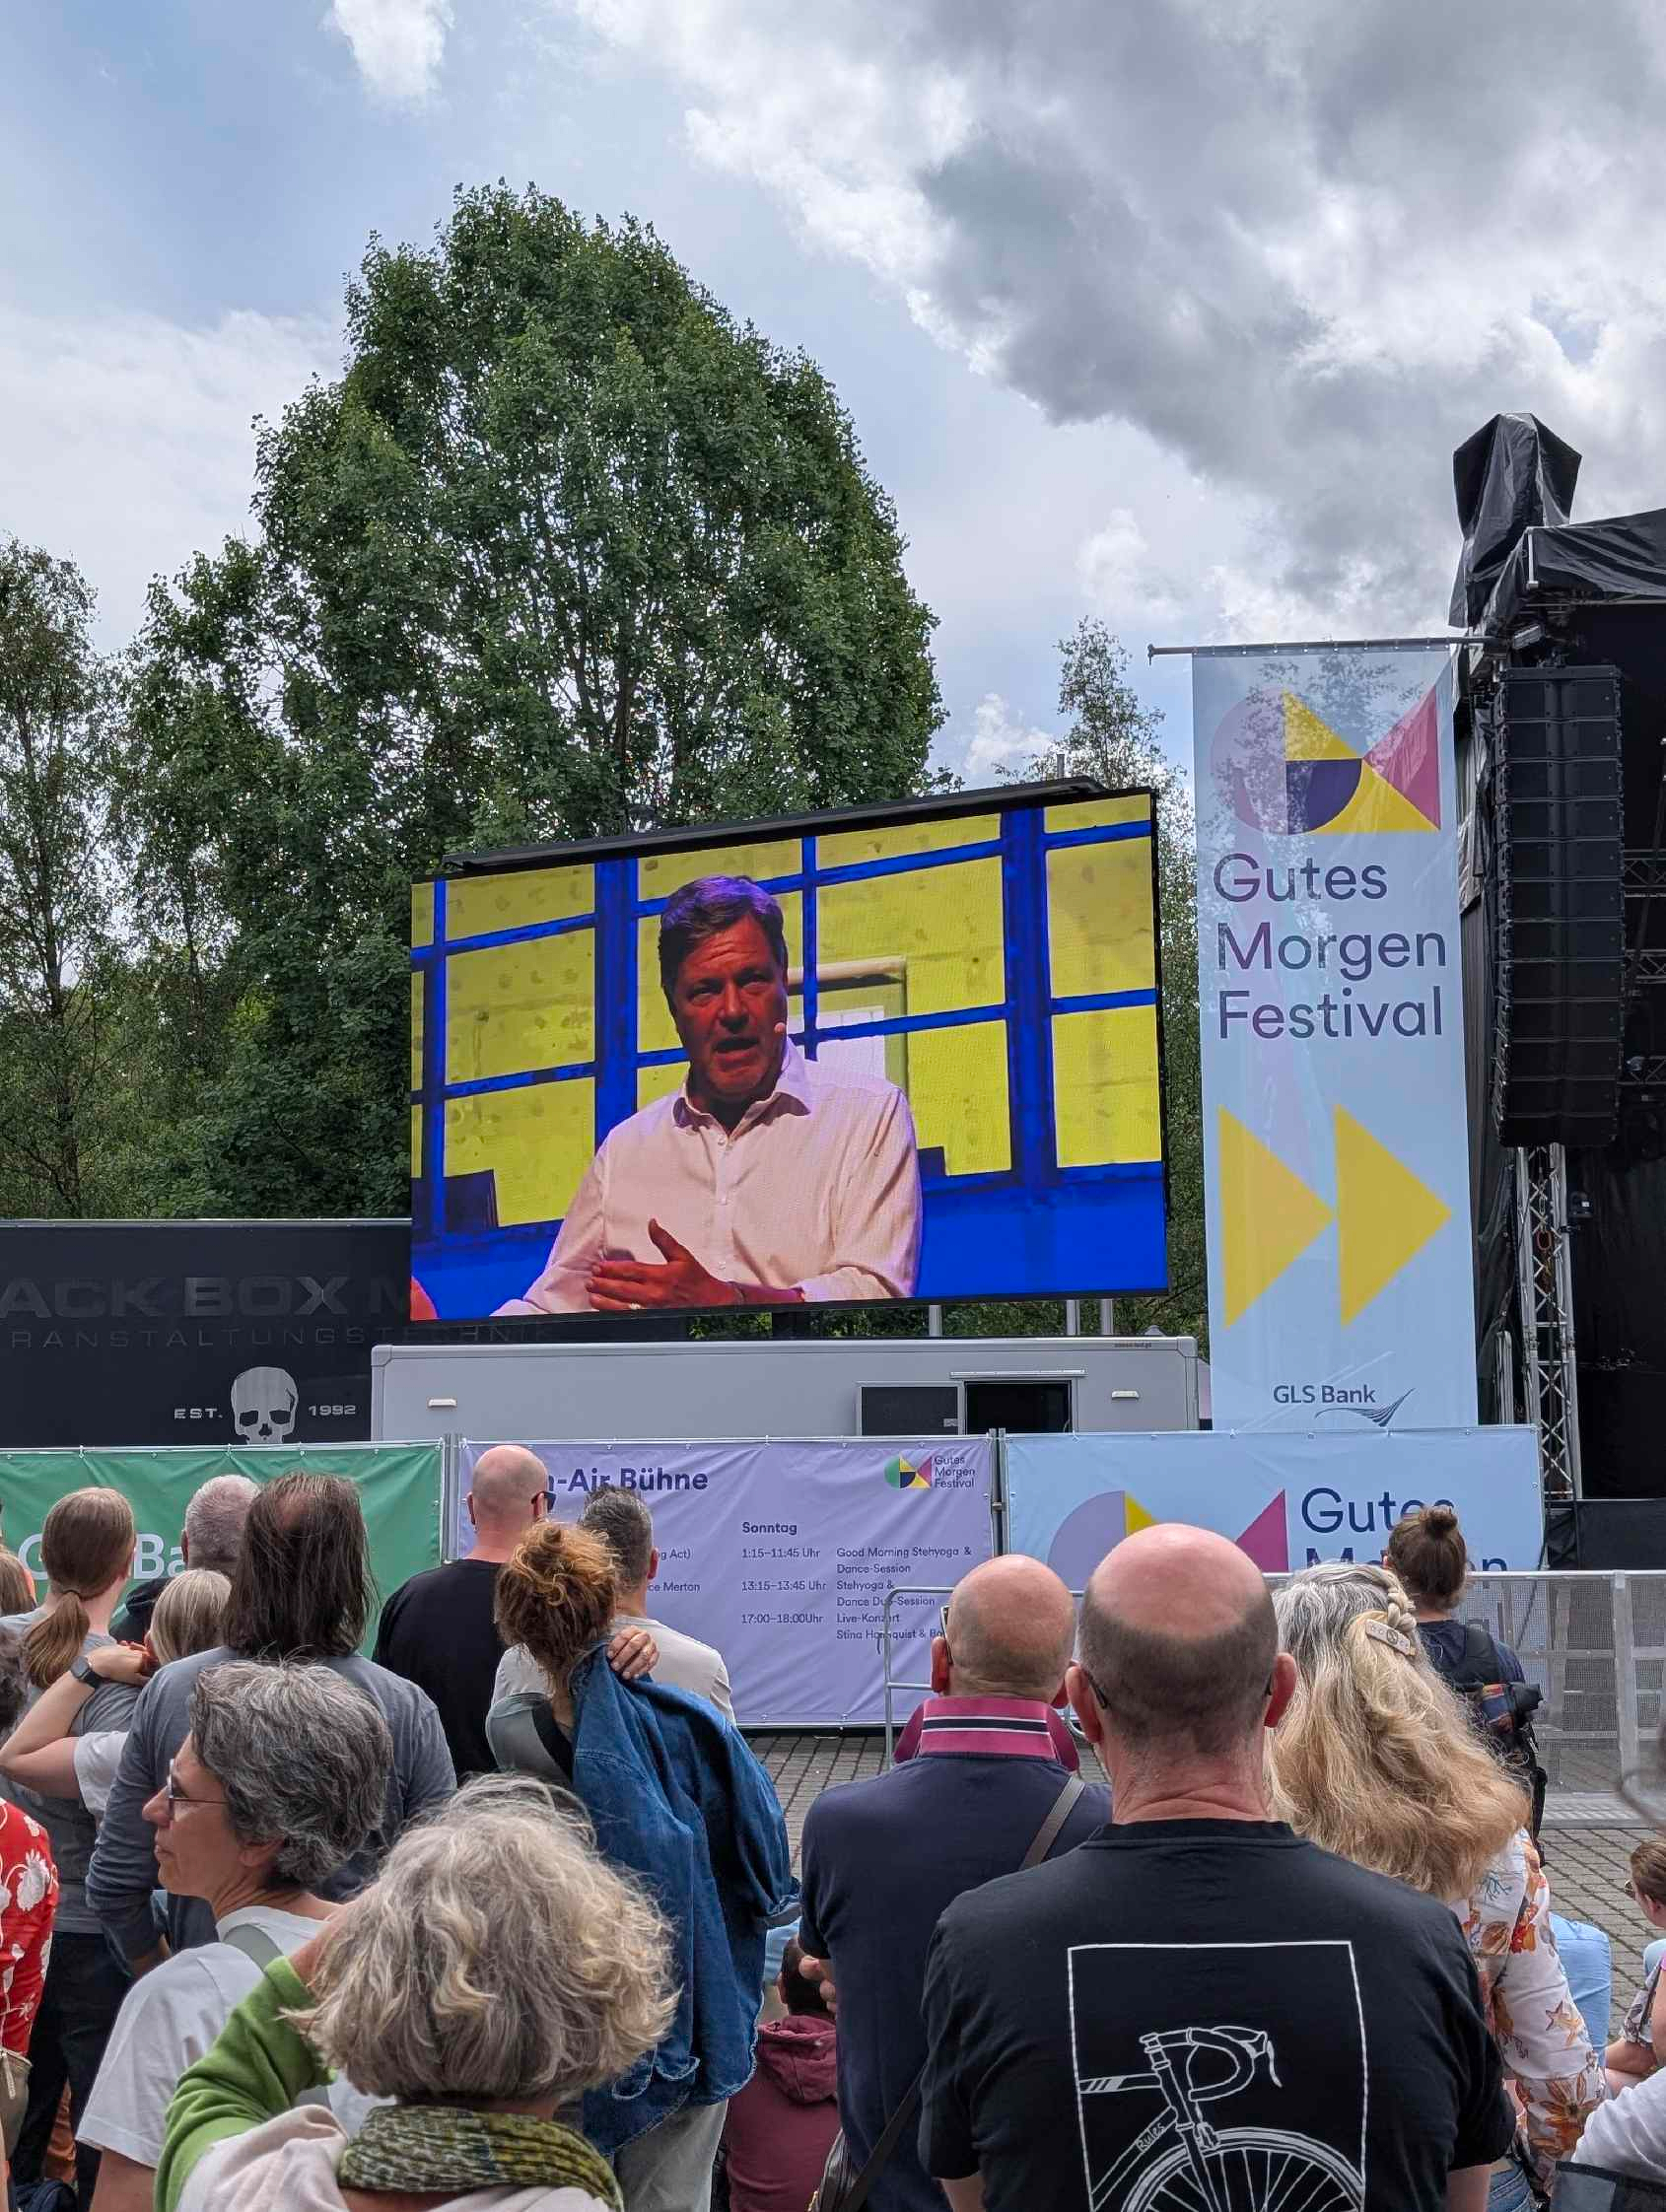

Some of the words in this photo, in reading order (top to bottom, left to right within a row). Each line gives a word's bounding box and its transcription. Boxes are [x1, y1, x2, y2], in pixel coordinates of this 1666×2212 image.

[1213, 853, 1388, 902] Gutes
[1216, 921, 1447, 982] Morgen
[1218, 985, 1443, 1040] Festival
[184, 1276, 348, 1316] BOX
[1273, 1384, 1316, 1404] GLS
[1321, 1383, 1376, 1404] Bank
[174, 1408, 224, 1419] EST.
[308, 1405, 356, 1417] 1992
[934, 1455, 965, 1466] Gutes
[620, 1466, 709, 1491] Bühne
[935, 1466, 975, 1481] Morgen
[935, 1478, 974, 1488] Festival
[741, 1521, 798, 1536] Sonntag
[802, 1548, 820, 1557] Uhr
[836, 1547, 865, 1557] Good
[868, 1547, 910, 1558] Morning
[913, 1546, 959, 1558] Stehyoga
[964, 1546, 972, 1555] &
[836, 1563, 911, 1573] Dance-Session
[663, 1581, 701, 1592] Merton
[742, 1579, 805, 1591] 13:15–13:45
[808, 1579, 827, 1590] Uhr
[836, 1580, 884, 1592] Stehyoga
[836, 1596, 869, 1607] Dance
[836, 1628, 863, 1639] Stina
